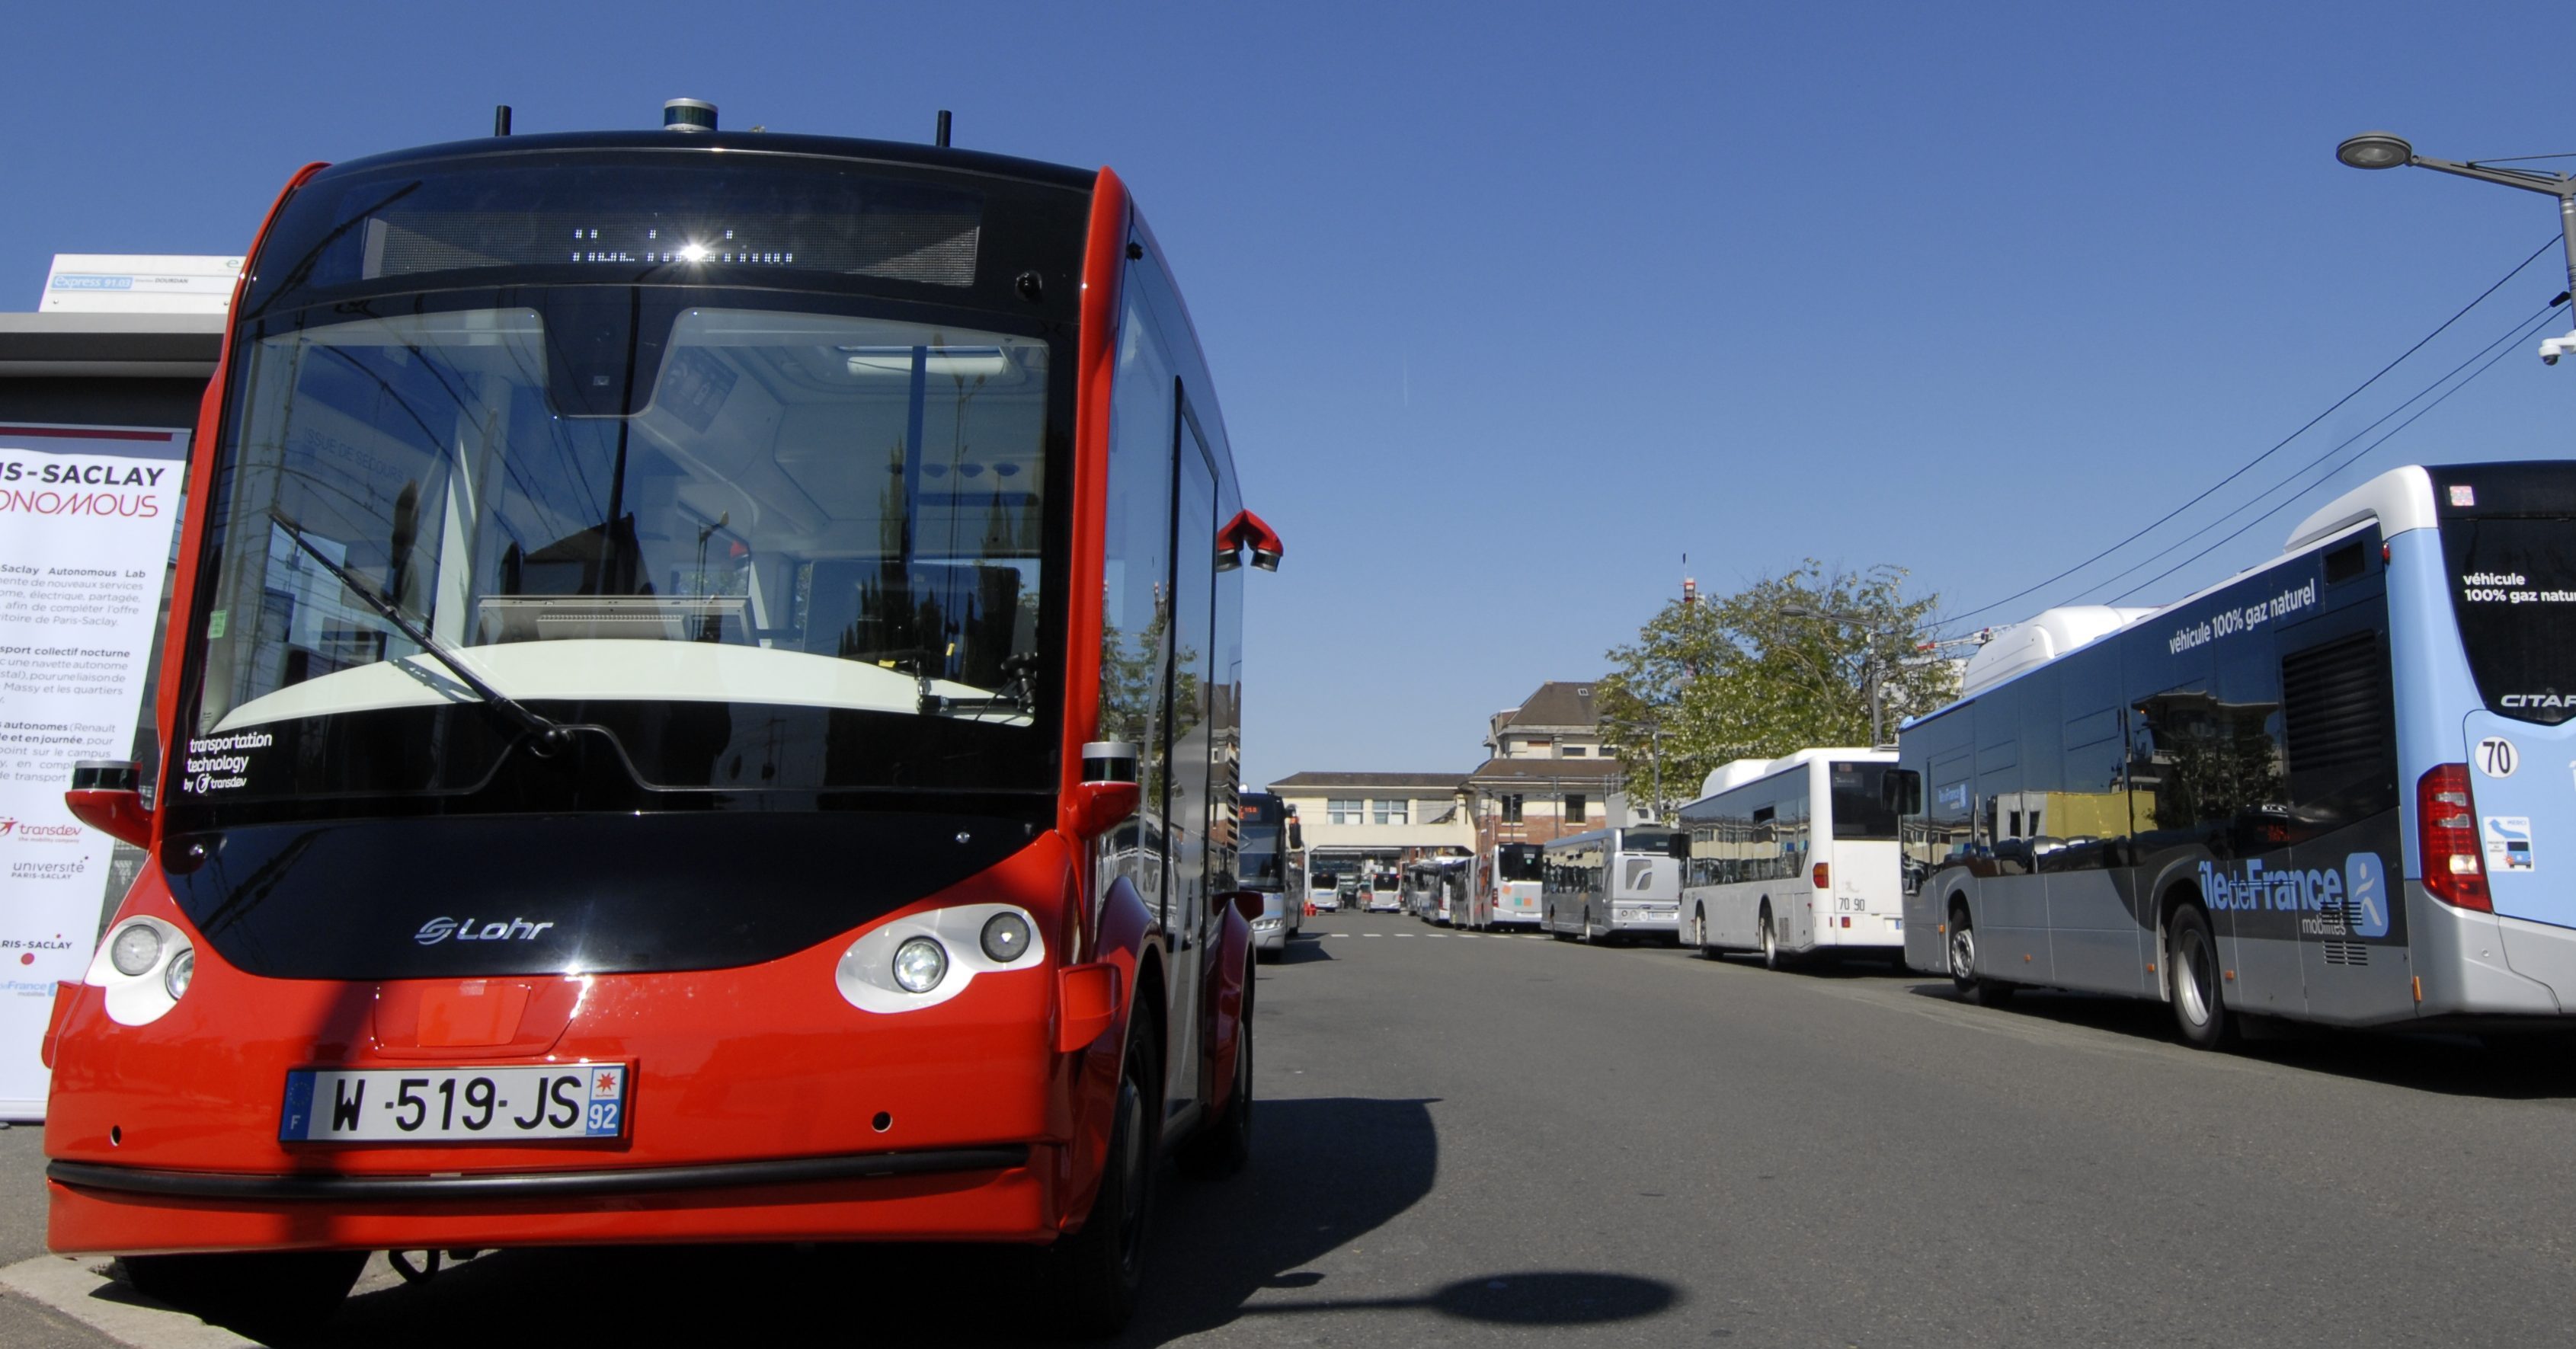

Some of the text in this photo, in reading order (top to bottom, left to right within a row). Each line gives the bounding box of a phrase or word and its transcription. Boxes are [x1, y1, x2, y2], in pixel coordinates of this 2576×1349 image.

[55, 276, 101, 288] express
[104, 279, 131, 287] 91.03
[49, 567, 117, 577] Autonomous
[126, 570, 146, 578] Lab
[2462, 572, 2526, 586] véhicule
[30, 578, 46, 587] de
[47, 580, 97, 589] nouveaux
[30, 591, 85, 601] électrique,
[88, 593, 140, 603] partagée,
[2464, 589, 2507, 602] 100%
[2509, 591, 2538, 603] gaz
[5, 601, 27, 610] afin
[50, 604, 103, 614] compléter
[107, 605, 139, 615] l'offre
[0, 613, 119, 627] itoire de Paris-Saclay.
[2169, 577, 2316, 654] véhicule 100% gaz naturel
[34, 647, 78, 656] collectif
[80, 649, 130, 658] nocturne
[31, 660, 71, 669] navette
[72, 662, 128, 670] autonome
[30, 673, 57, 682] pour
[76, 673, 110, 682] liaison
[111, 675, 126, 683] de
[4, 682, 123, 695] Massy et les quartiers
[4, 722, 68, 731] autonomes
[69, 724, 116, 733] (Renault
[190, 731, 273, 754] transportation
[68, 750, 111, 759] campus
[2482, 741, 2510, 774] 70
[40, 762, 76, 772] compl
[187, 755, 250, 773] technology
[14, 772, 66, 782] transport
[183, 776, 248, 792] by transdev
[19, 824, 82, 836] transdev
[13, 859, 85, 872] université
[1838, 897, 1865, 912] 70 90
[457, 917, 554, 941] Lohr
[0, 940, 72, 949] RIS-SACLAY
[290, 1115, 301, 1130] F
[588, 1103, 618, 1130] 92
